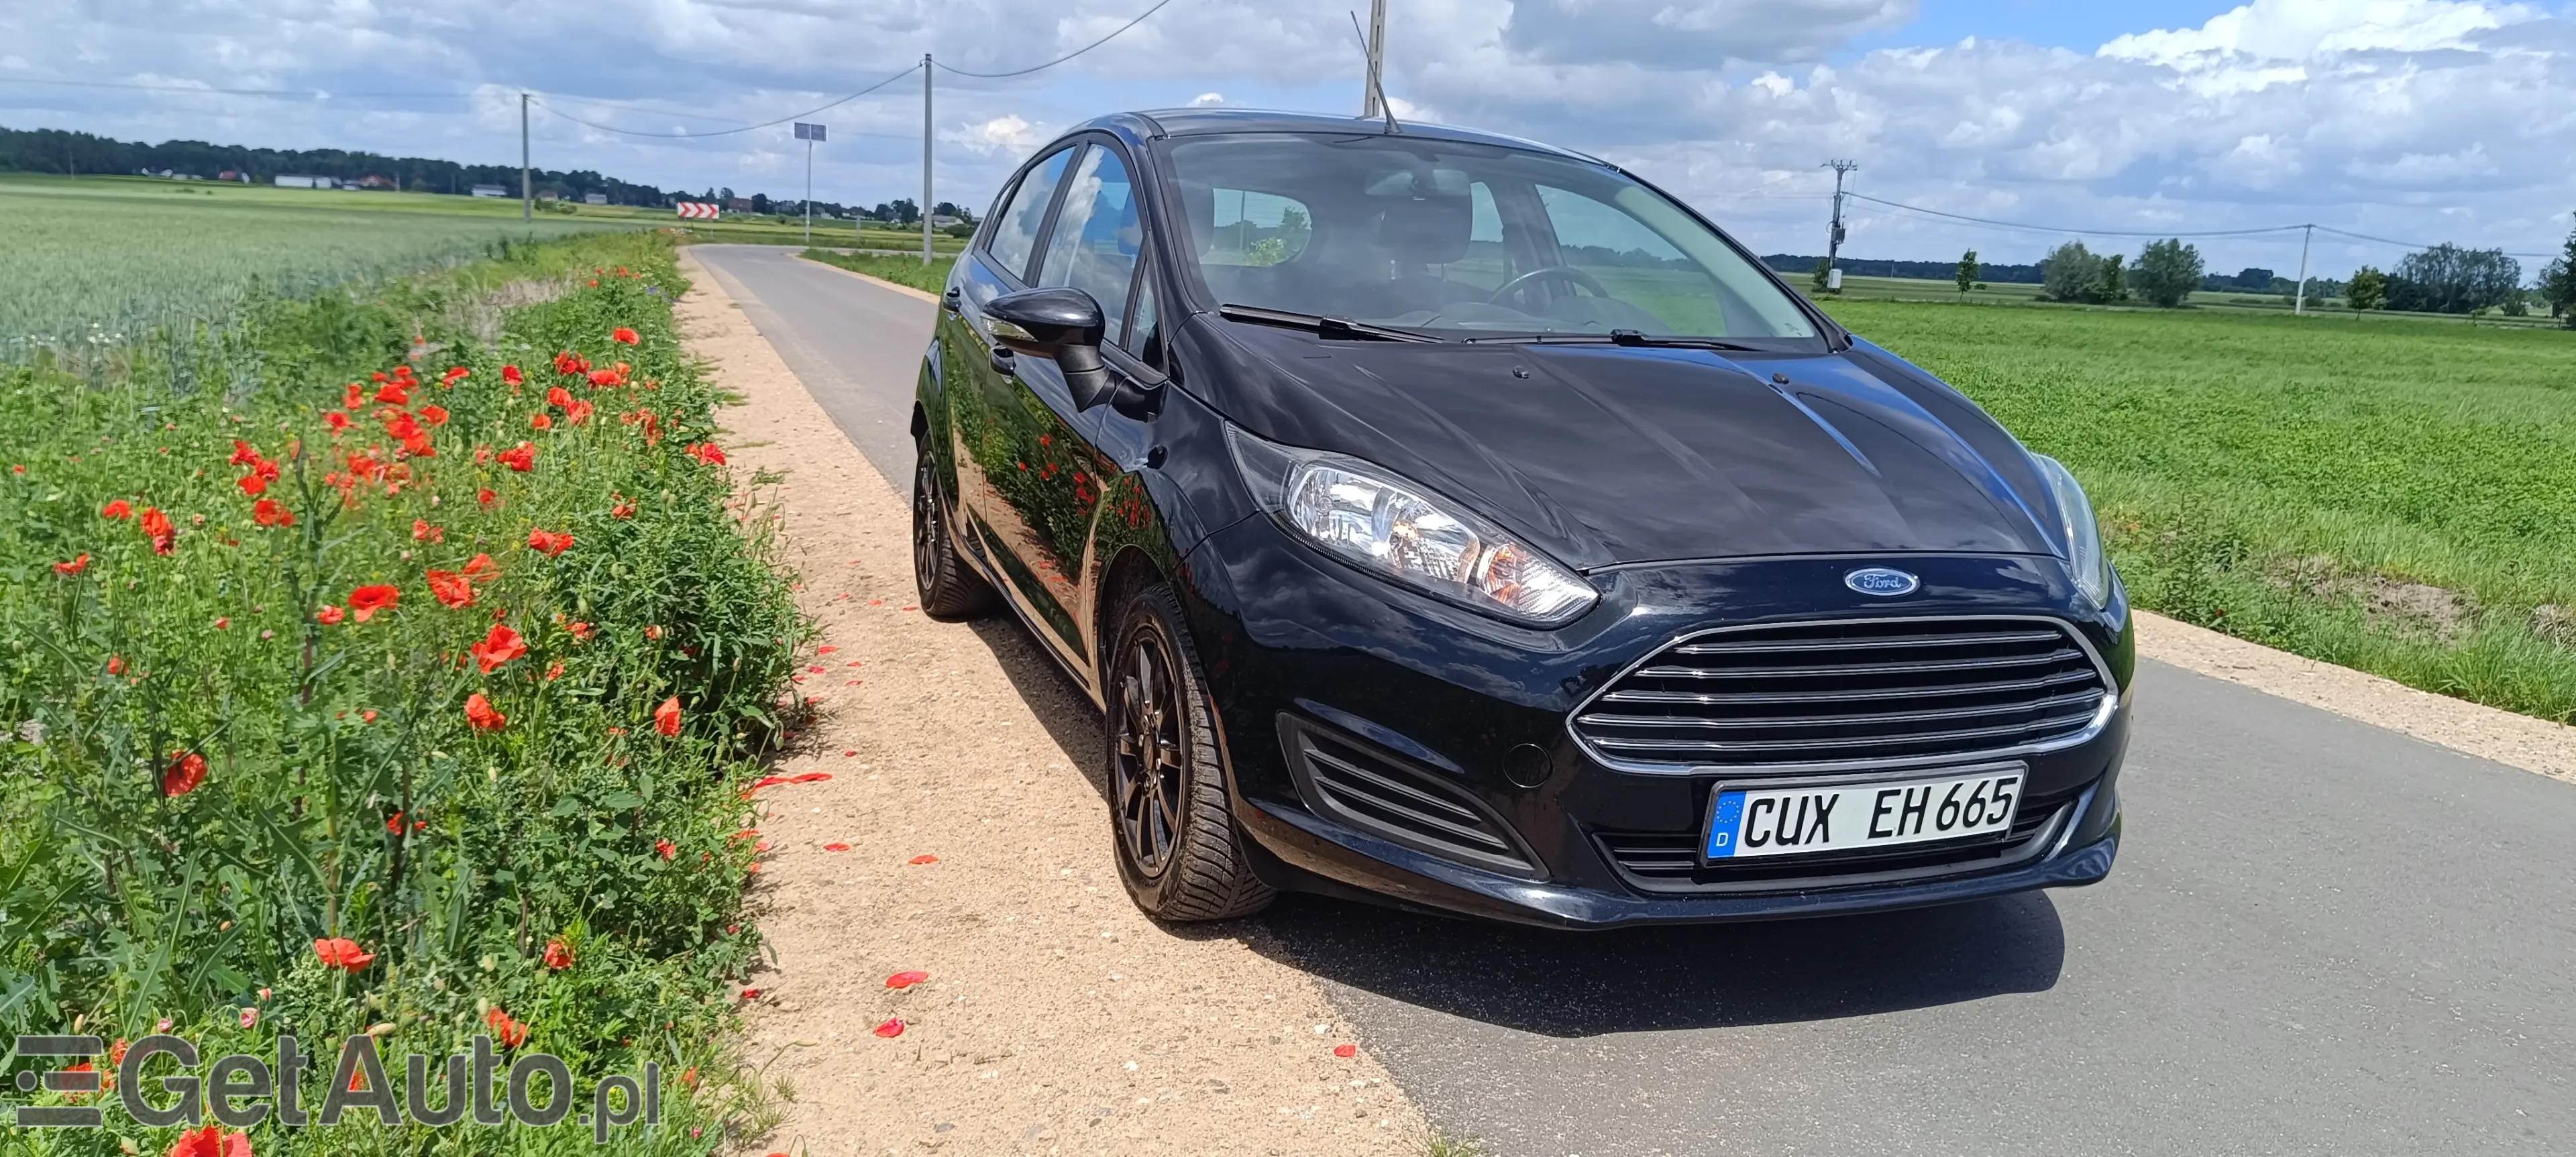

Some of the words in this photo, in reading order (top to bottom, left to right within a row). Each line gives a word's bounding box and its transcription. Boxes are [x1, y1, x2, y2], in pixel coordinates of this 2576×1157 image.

[1864, 574, 1901, 588] Ford
[1744, 793, 1839, 848] CUX
[1716, 832, 1728, 846] D
